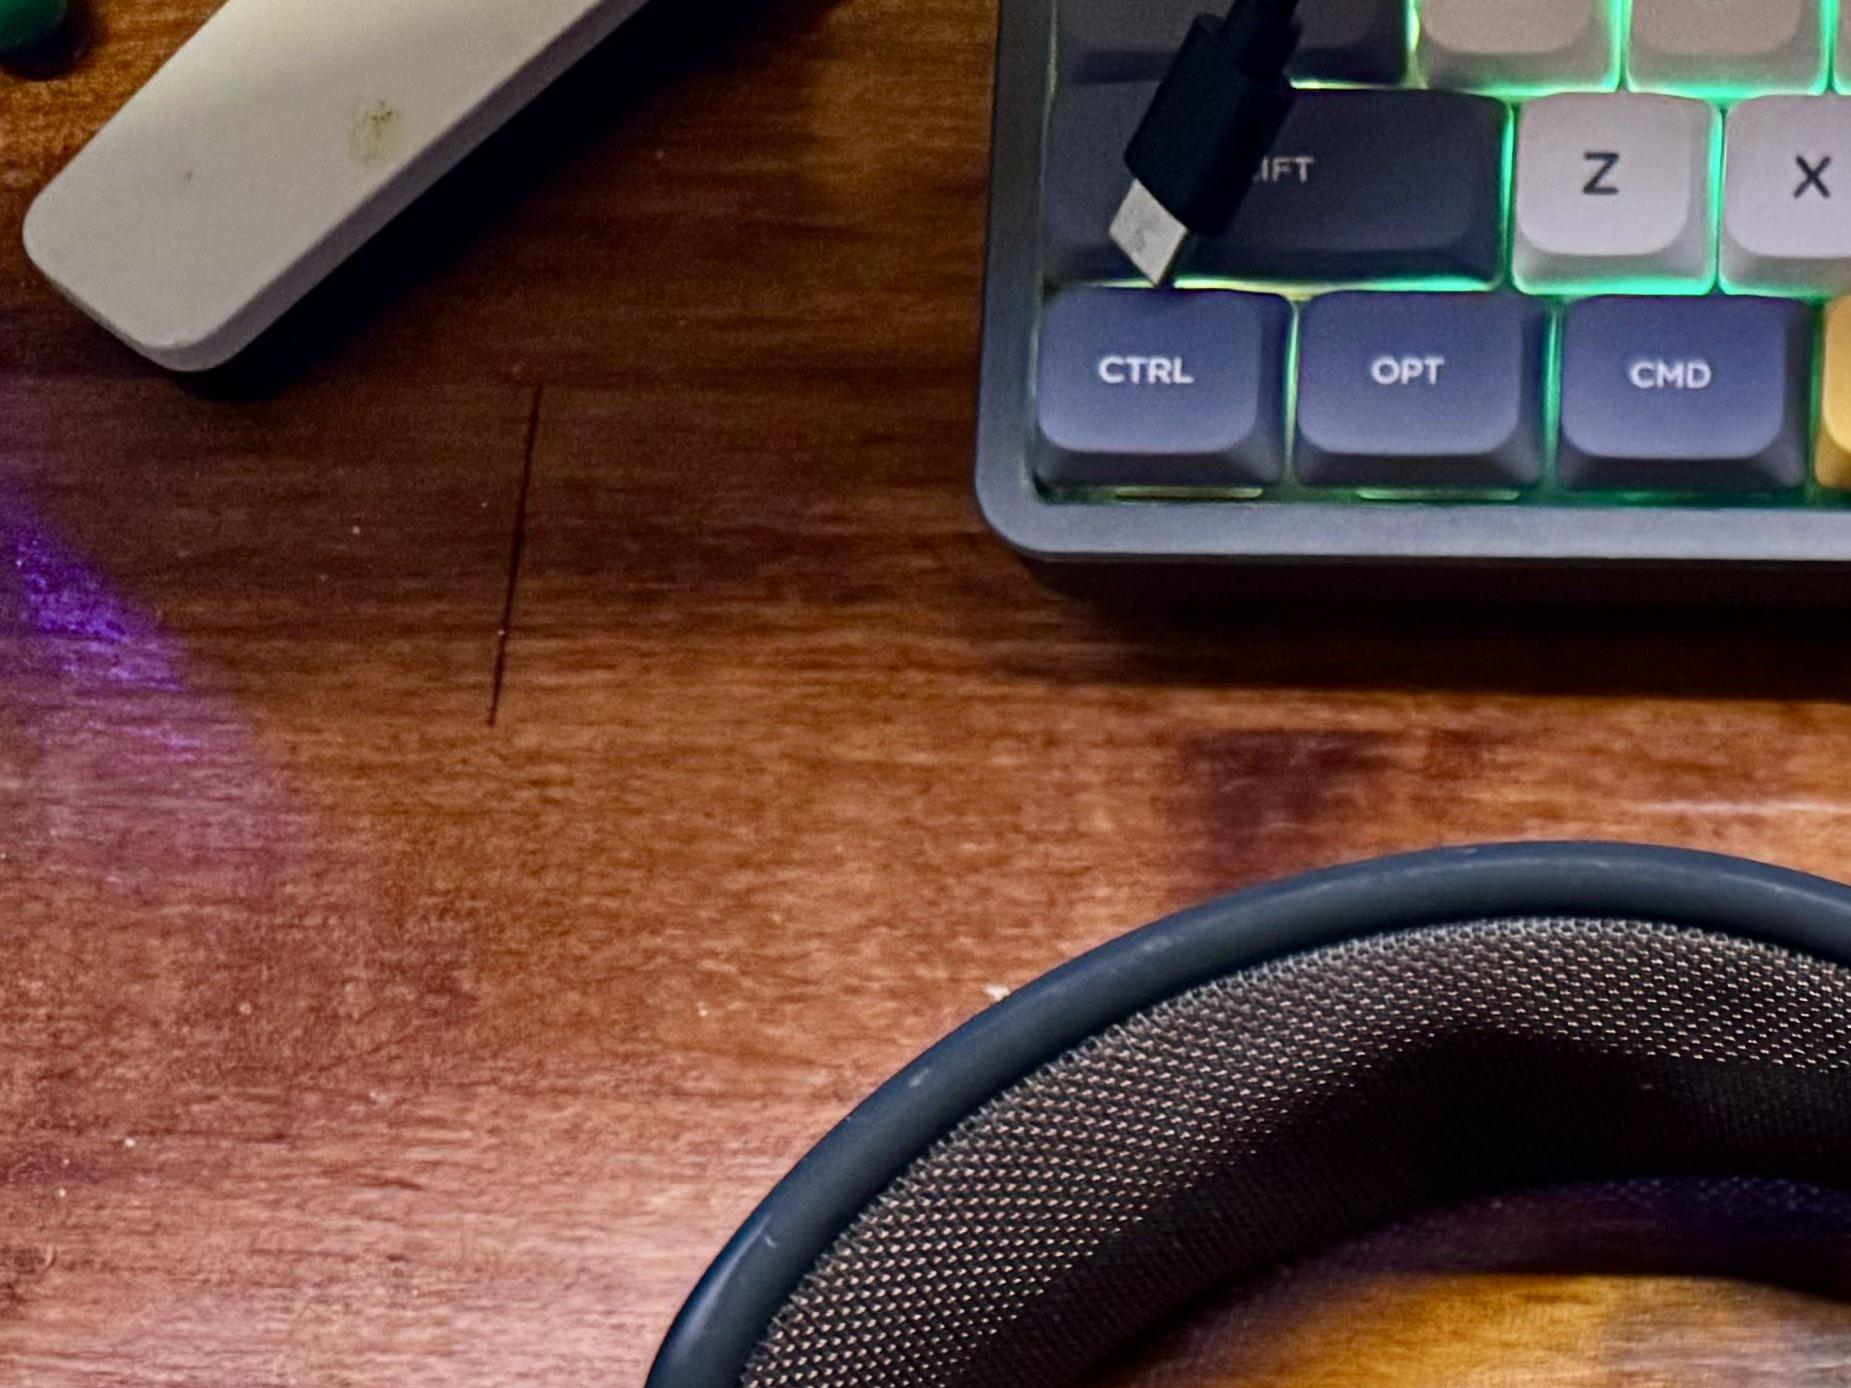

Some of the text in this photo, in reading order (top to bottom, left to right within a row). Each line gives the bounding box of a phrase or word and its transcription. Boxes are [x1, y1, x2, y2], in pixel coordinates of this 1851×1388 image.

[1254, 156, 1315, 183] IFT
[1582, 151, 1620, 195] Z
[1793, 155, 1831, 198] X
[1098, 355, 1194, 384] CTRL
[1371, 357, 1444, 385] OPT
[1629, 361, 1711, 389] CMD
